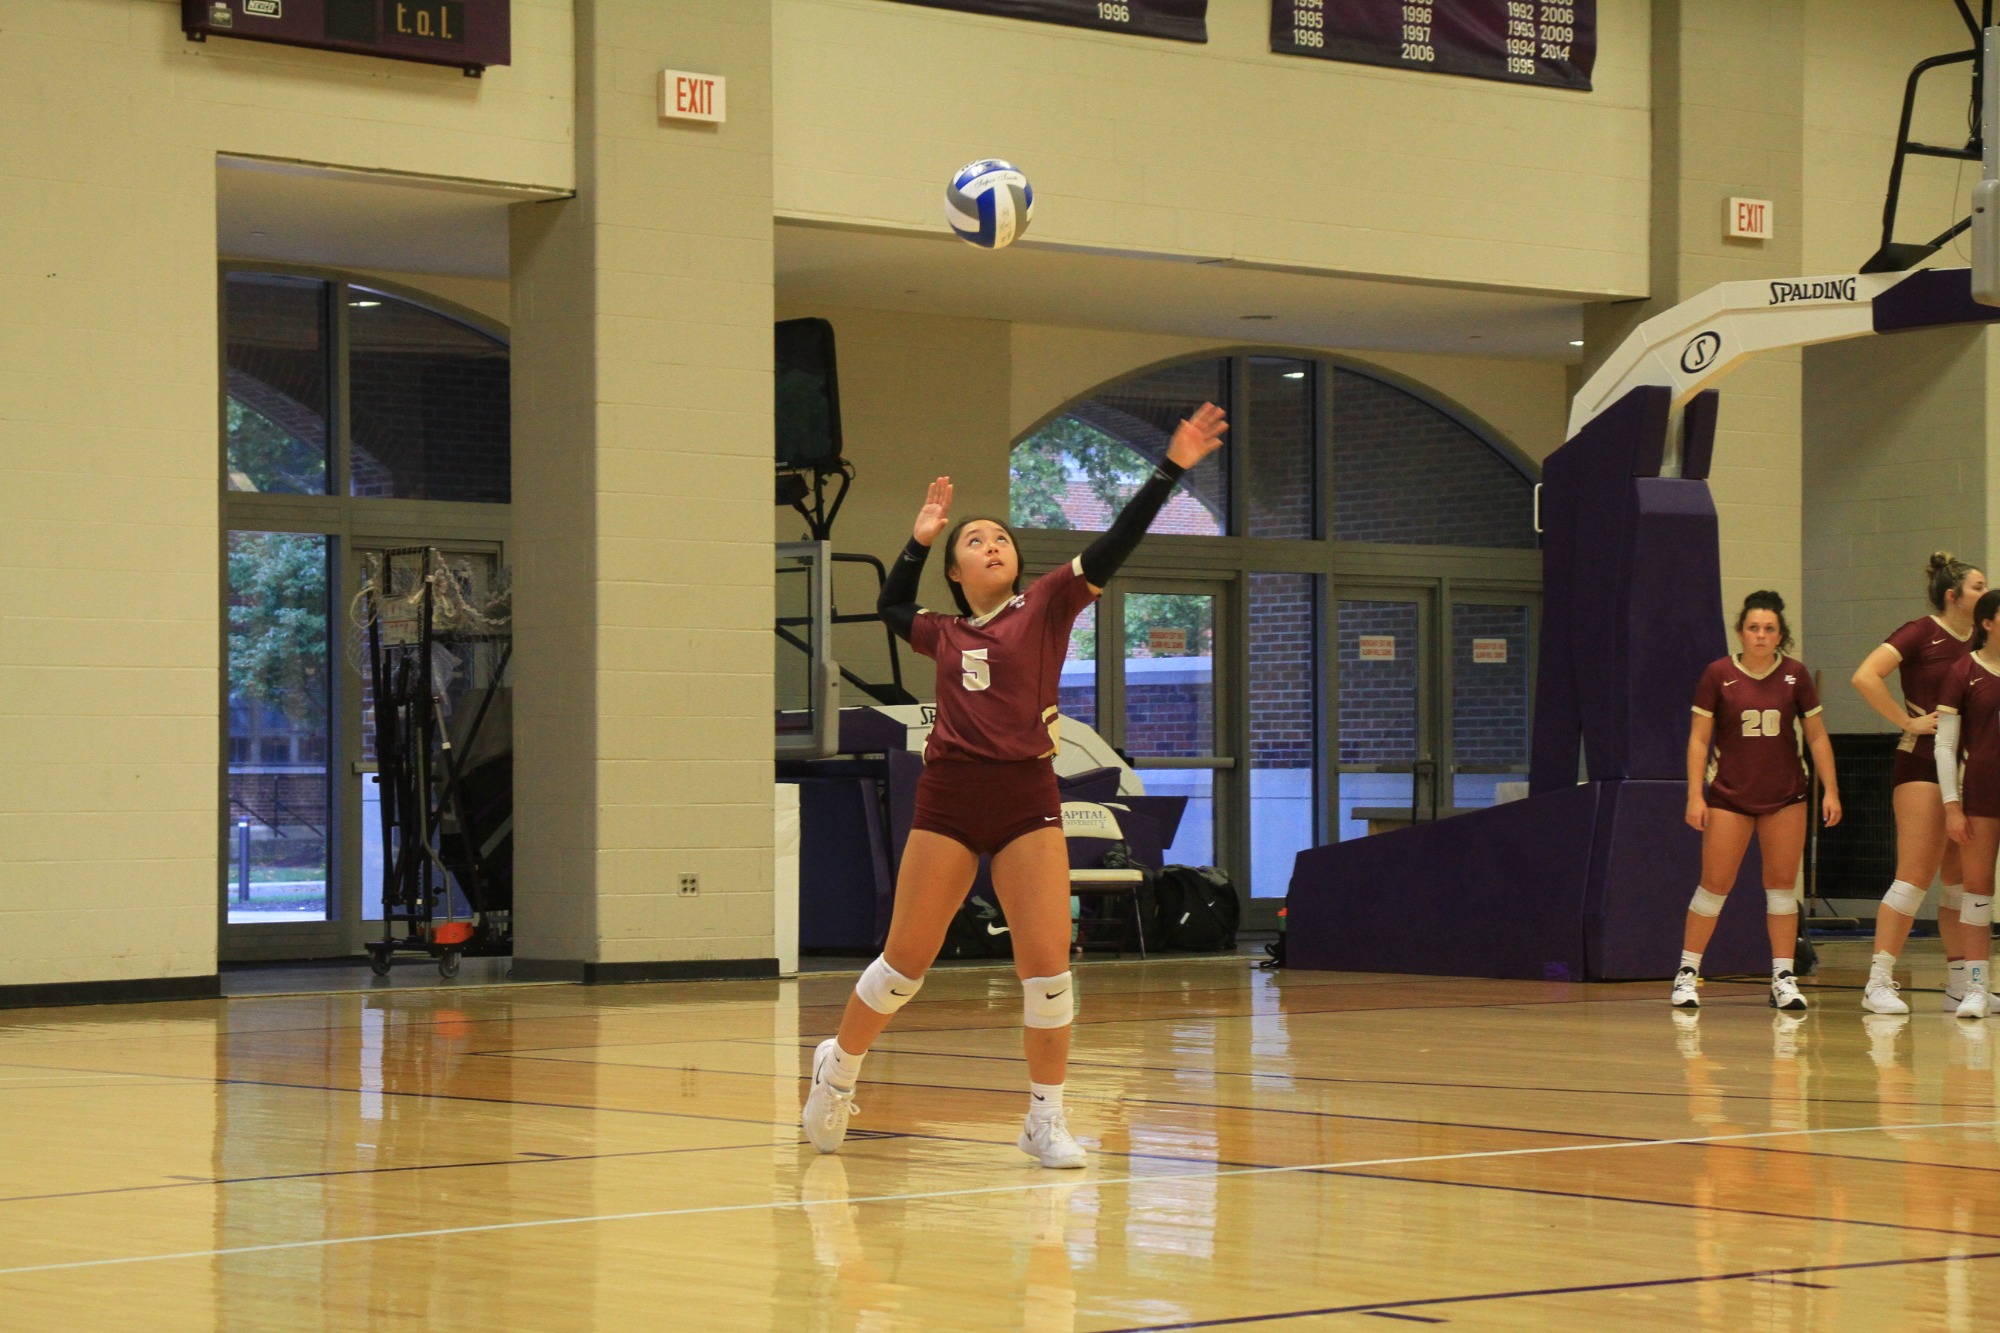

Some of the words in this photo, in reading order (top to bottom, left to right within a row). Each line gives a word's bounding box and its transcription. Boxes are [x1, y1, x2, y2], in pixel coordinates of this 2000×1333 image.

[1097, 2, 1129, 22] 1996
[1293, 9, 1323, 28] 1995
[1402, 5, 1432, 24] 1996
[1507, 1, 1534, 20] 1992
[1541, 6, 1574, 24] 2006
[1293, 29, 1324, 47] 1996
[1402, 24, 1431, 42] 1997
[1508, 20, 1535, 38] 1993
[1540, 25, 1573, 43] 2009
[1401, 43, 1435, 62] 2006
[1506, 39, 1536, 56] 1994
[1541, 43, 1570, 61] 2014
[1507, 57, 1535, 75] 1995
[677, 77, 714, 115] EXIT
[1738, 203, 1765, 233] EXIT
[1769, 277, 1857, 305] SPALDING
[962, 648, 991, 691] 5
[1741, 709, 1781, 737] 20
[1062, 810, 1107, 819] APITAL
